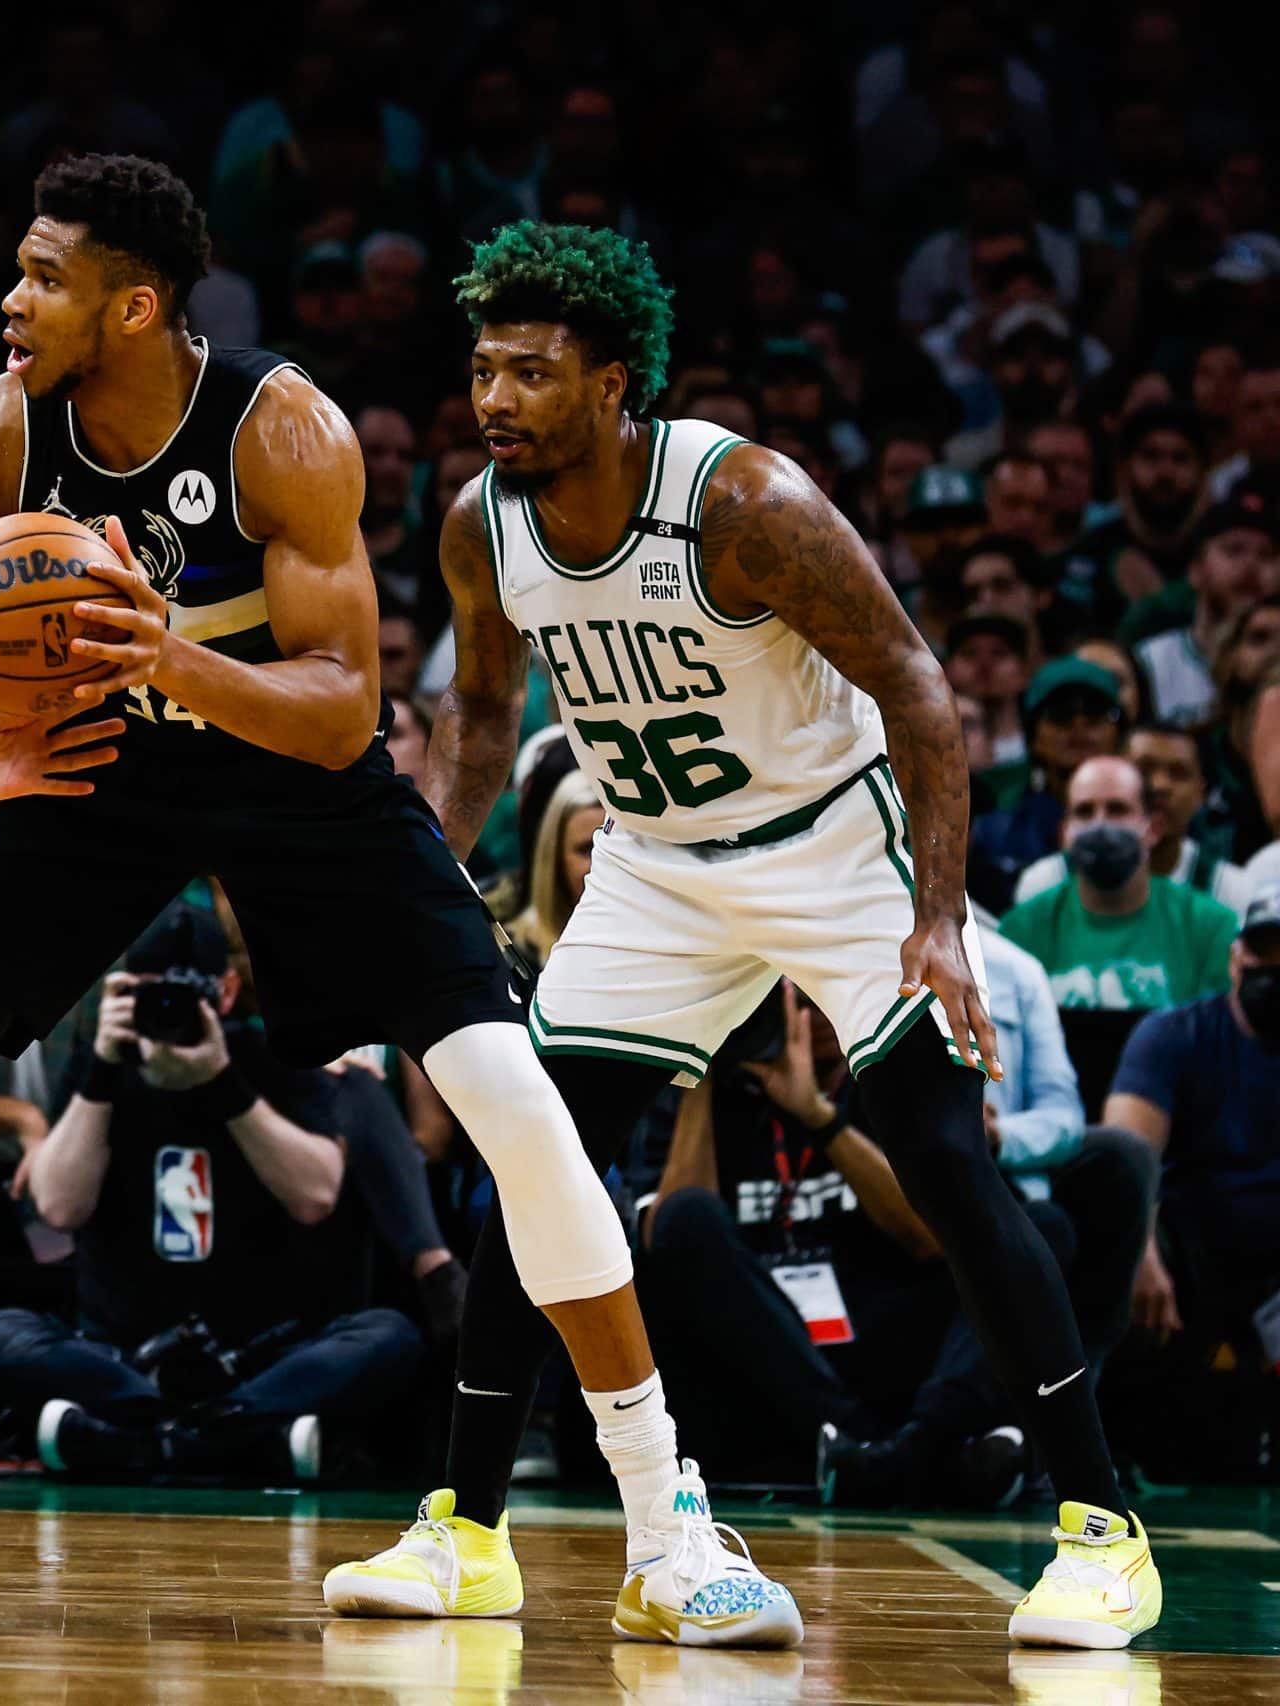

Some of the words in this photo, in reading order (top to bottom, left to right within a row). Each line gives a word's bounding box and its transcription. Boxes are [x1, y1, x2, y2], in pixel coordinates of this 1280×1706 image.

[658, 522, 672, 536] 24
[639, 562, 680, 584] VISTA
[641, 584, 681, 600] PRINT
[574, 711, 752, 818] 36
